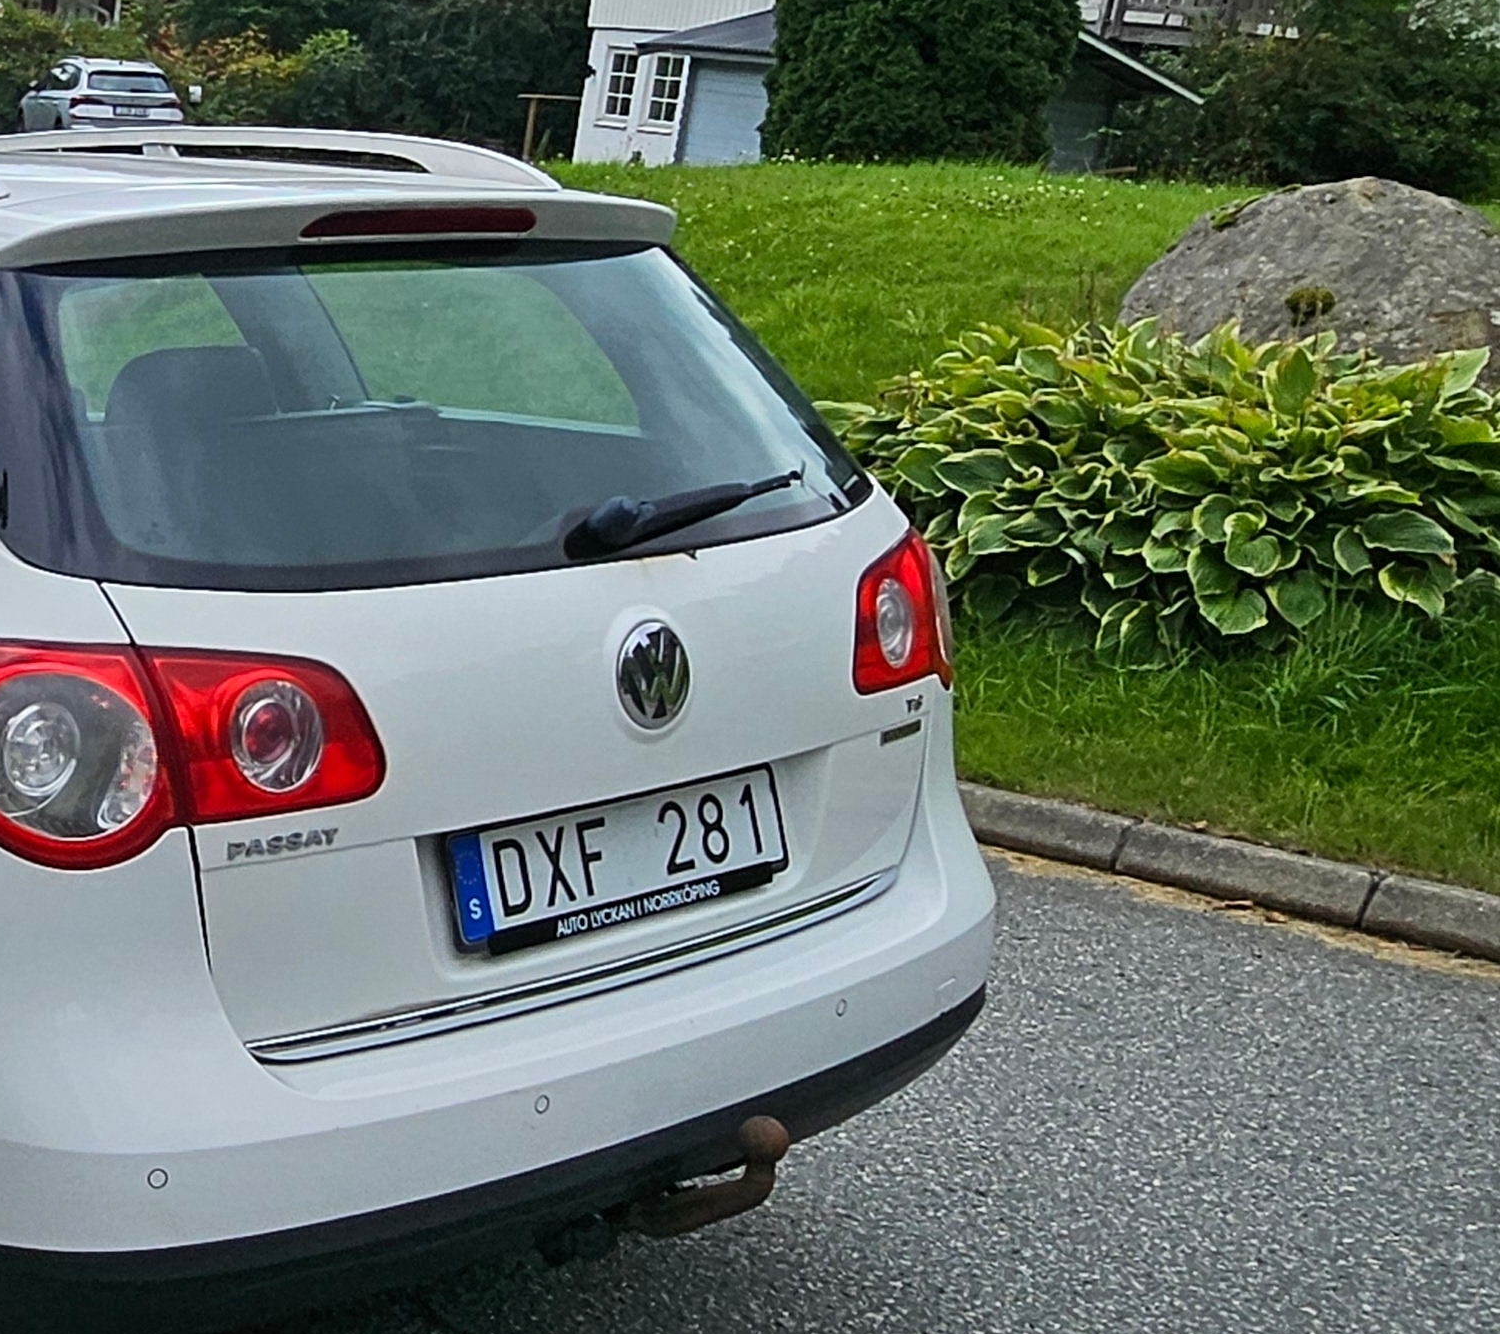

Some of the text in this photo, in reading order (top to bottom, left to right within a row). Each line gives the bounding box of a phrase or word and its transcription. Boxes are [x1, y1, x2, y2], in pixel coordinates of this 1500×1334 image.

[226, 827, 339, 862] PASSAT
[491, 783, 764, 918] DXF 281
[468, 898, 482, 920] S
[556, 913, 589, 938] AUTO
[590, 901, 636, 929] LYCKAN
[643, 879, 721, 915] NORRKÖPING
